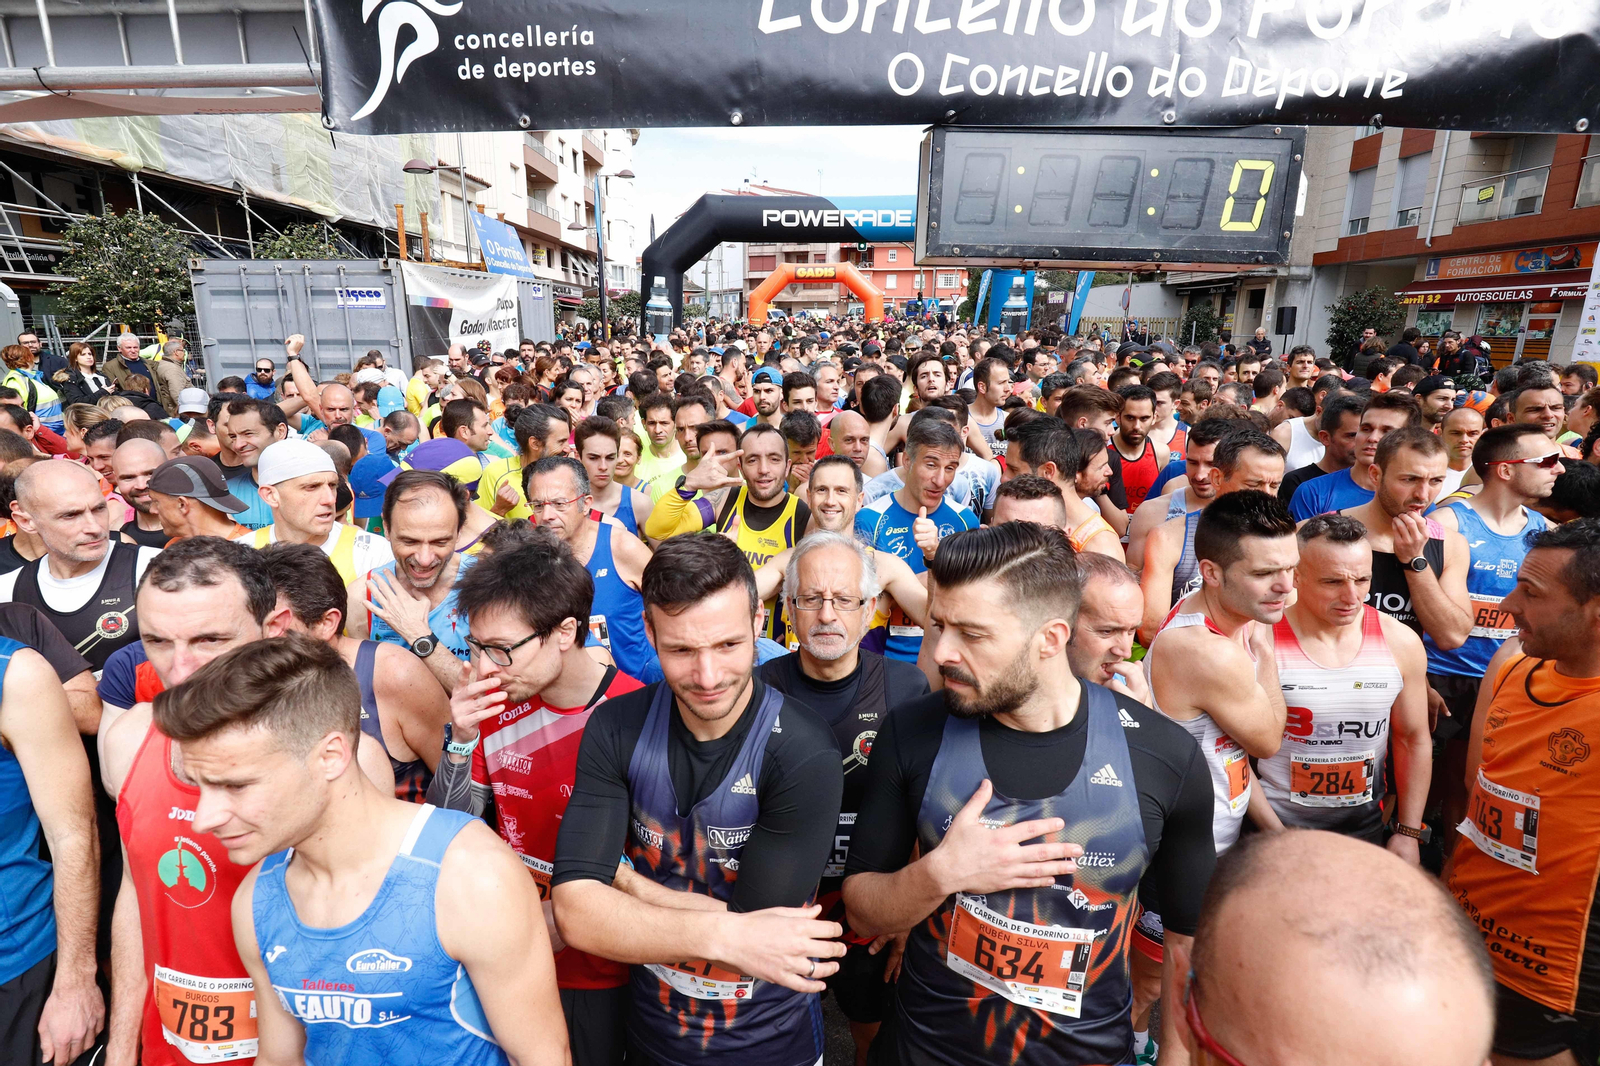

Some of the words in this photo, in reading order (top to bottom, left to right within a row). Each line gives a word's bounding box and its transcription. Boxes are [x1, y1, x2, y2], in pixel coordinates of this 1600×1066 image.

[454, 24, 595, 50] concellería
[457, 57, 485, 80] de
[493, 56, 597, 83] deportes
[887, 52, 925, 96] O
[938, 51, 1134, 98] Concello
[1146, 54, 1207, 98] do
[1221, 56, 1408, 110] Deporte
[486, 239, 495, 255] O
[494, 241, 523, 262] Porriño
[1450, 255, 1487, 267] CENTRO
[1488, 254, 1502, 263] DE
[796, 267, 836, 278] GADIS
[1447, 263, 1501, 277] FORMACIÓN
[1426, 294, 1442, 304] 32
[1454, 290, 1533, 302] AUTOESCUELAS
[460, 320, 487, 335] Godoy
[1501, 561, 1513, 570] blu
[1475, 608, 1510, 629] 697
[1120, 720, 1140, 728] das
[1288, 736, 1318, 746] PEDRO
[503, 754, 533, 772] MARATON
[1090, 777, 1123, 787] adidas
[1310, 771, 1355, 795] 284
[731, 786, 757, 795] adidas
[710, 829, 750, 848] Natte
[540, 863, 547, 871] DE
[973, 906, 1009, 931] CARREIRA
[1010, 923, 1021, 932] DE
[1023, 926, 1031, 934] O
[1032, 927, 1070, 940] PORRIÑO
[1458, 889, 1547, 958] Panadería
[979, 923, 1011, 943] RUBÉN
[1016, 937, 1050, 950] SILVA
[356, 960, 400, 970] EuroTaller
[973, 933, 1044, 984] 634
[168, 974, 197, 987] CARREIRA
[198, 981, 207, 989] DE
[217, 980, 253, 990] PORRIÑO
[301, 979, 355, 992] Talleres
[185, 991, 220, 1003] BURGOS
[172, 998, 235, 1041] 783
[378, 1010, 400, 1022] S.L.
